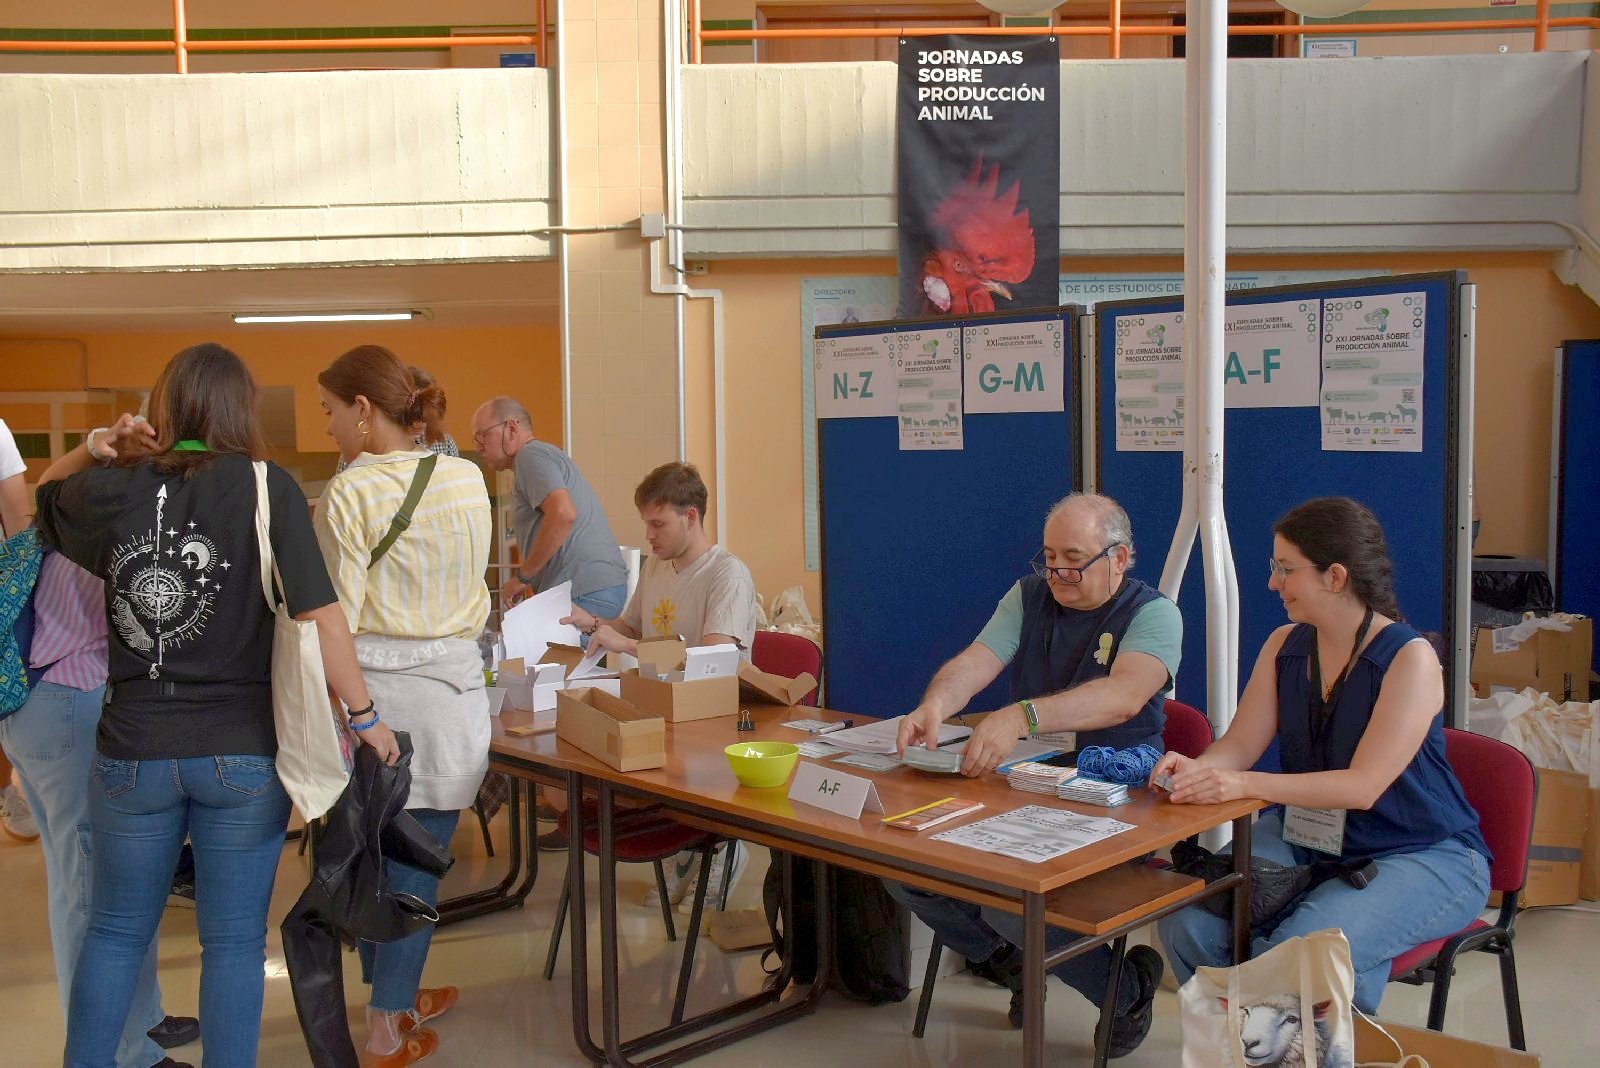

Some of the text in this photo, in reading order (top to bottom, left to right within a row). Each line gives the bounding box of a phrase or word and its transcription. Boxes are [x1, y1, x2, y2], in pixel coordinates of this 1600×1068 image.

[918, 50, 1024, 64] JORNADAS
[918, 68, 982, 82] SOBRE
[918, 83, 1045, 101] PRODUCCIÓN
[918, 106, 993, 120] ANIMAL
[814, 288, 856, 296] DIRECTORES
[1066, 285, 1080, 294] DE
[1084, 284, 1104, 293] LOS
[1108, 283, 1163, 293] ESTUDIOS
[1166, 283, 1181, 292] DE
[986, 339, 998, 347] XXI
[1349, 334, 1384, 342] JORNADAS
[1386, 332, 1410, 340] SOBRE
[1336, 342, 1380, 351] PRODUCCIÓN
[1224, 348, 1280, 384] A-F
[979, 361, 1045, 394] G-M
[833, 371, 873, 400] N-Z
[818, 779, 841, 795] A-F
